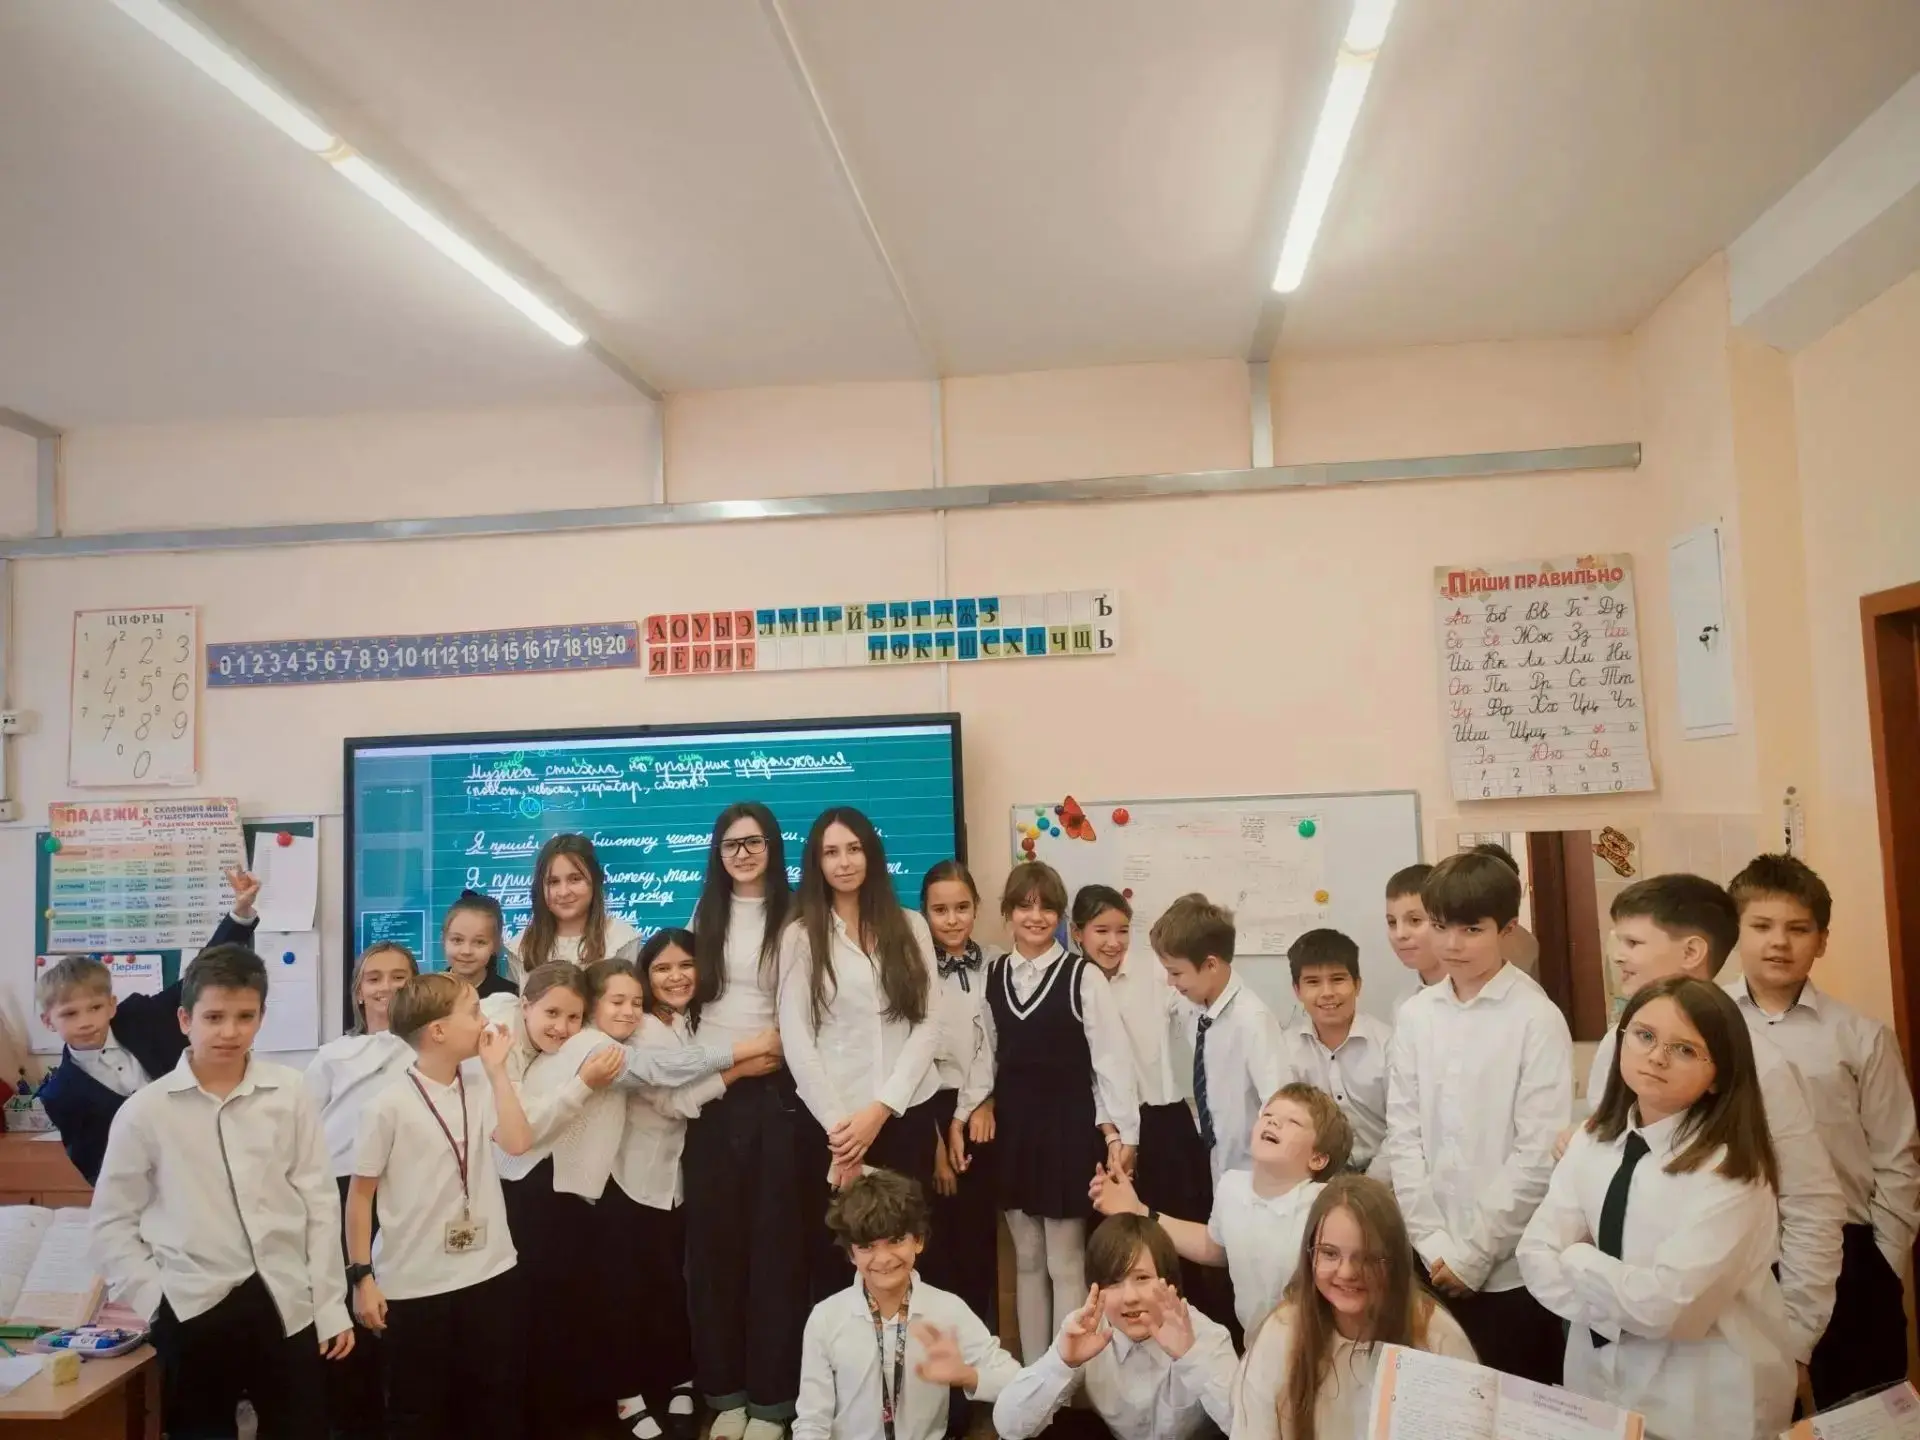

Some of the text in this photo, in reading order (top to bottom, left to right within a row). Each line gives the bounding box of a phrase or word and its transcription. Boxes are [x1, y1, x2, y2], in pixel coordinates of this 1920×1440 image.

[1448, 568, 1625, 594] ПИШИ ПРАВИЛЬНО
[107, 614, 164, 627] ЦИФРЫ
[651, 620, 668, 640] А
[671, 618, 689, 638] О
[692, 618, 709, 637] У
[713, 618, 732, 637] Ы
[738, 615, 753, 634] Э
[759, 613, 774, 634] Л
[780, 613, 798, 633] М
[804, 611, 819, 632] П
[827, 611, 840, 631] Р
[848, 607, 863, 630] Й
[871, 609, 885, 628] Б
[894, 608, 907, 627] В
[915, 607, 928, 626] Г
[937, 605, 953, 625] Д
[960, 604, 977, 624] Ж
[984, 605, 996, 623] З
[105, 637, 118, 667] 1
[119, 631, 127, 641] 2
[138, 636, 154, 664] 2
[175, 635, 190, 663] 3
[220, 656, 231, 675] 0
[237, 656, 246, 674] 1
[253, 655, 265, 673] 2
[270, 653, 281, 672] 3
[287, 652, 300, 671] 4
[307, 652, 319, 670] 5
[325, 651, 337, 670] 6
[342, 650, 353, 669] 7
[360, 649, 372, 668] 8
[378, 648, 390, 668] 9
[396, 647, 419, 667] 10
[421, 646, 438, 665] 11
[440, 645, 459, 665] 12
[461, 644, 480, 663] 13
[482, 643, 501, 662] 14
[502, 642, 519, 660] 15
[523, 640, 541, 659] 16
[543, 639, 561, 658] 17
[564, 638, 582, 656] 18
[584, 636, 603, 655] 19
[606, 635, 627, 655] 20
[653, 630, 1113, 671] Я Ё Ю И Е П Ф К Т Ш С Х Ц Ч Щ Ь
[103, 677, 117, 704] 4
[137, 675, 153, 703] 5
[172, 673, 189, 701] 6
[102, 713, 116, 742] 7
[135, 712, 152, 741] 8
[172, 711, 188, 740] 9
[117, 743, 152, 778] 0 0
[1512, 766, 1521, 779] 2
[1545, 764, 1554, 776] 3
[1611, 761, 1621, 774] 5
[66, 807, 140, 824] ПАДЕЖИ
[112, 962, 152, 973] Первые
